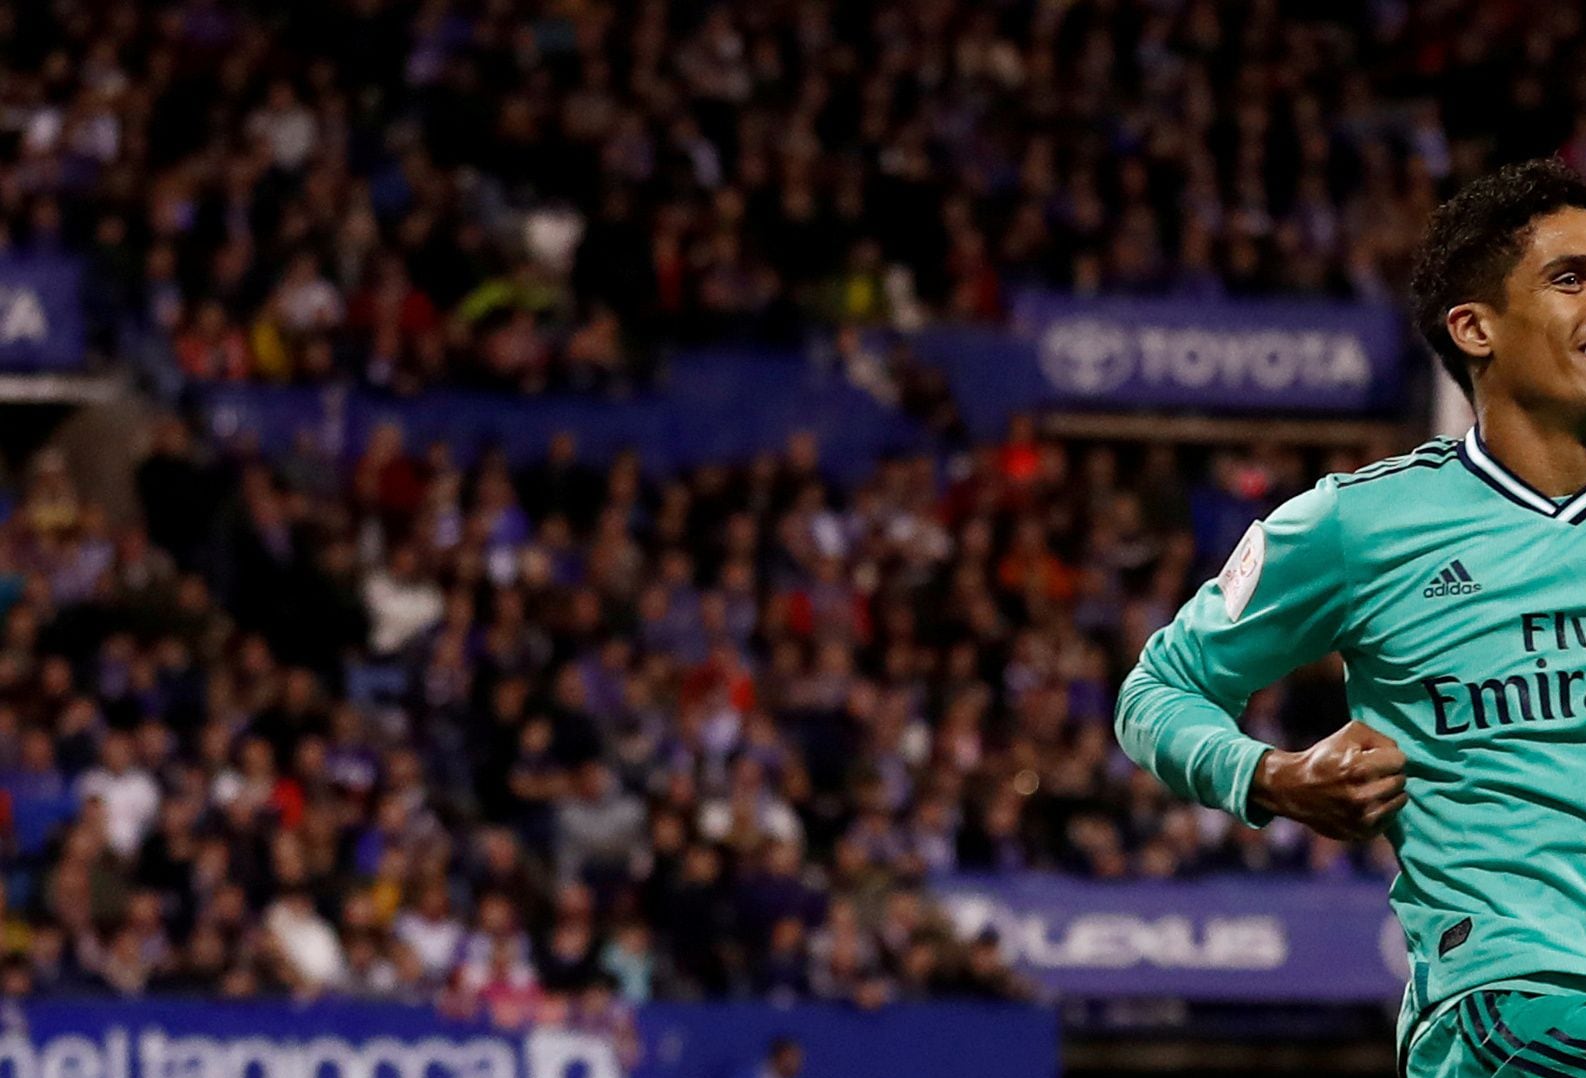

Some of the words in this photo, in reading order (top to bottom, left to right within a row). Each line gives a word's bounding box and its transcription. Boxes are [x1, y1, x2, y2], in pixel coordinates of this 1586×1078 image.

[1139, 327, 1370, 388] TOYOTA
[1423, 582, 1482, 598] adidas
[1020, 913, 1288, 972] LEXUS
